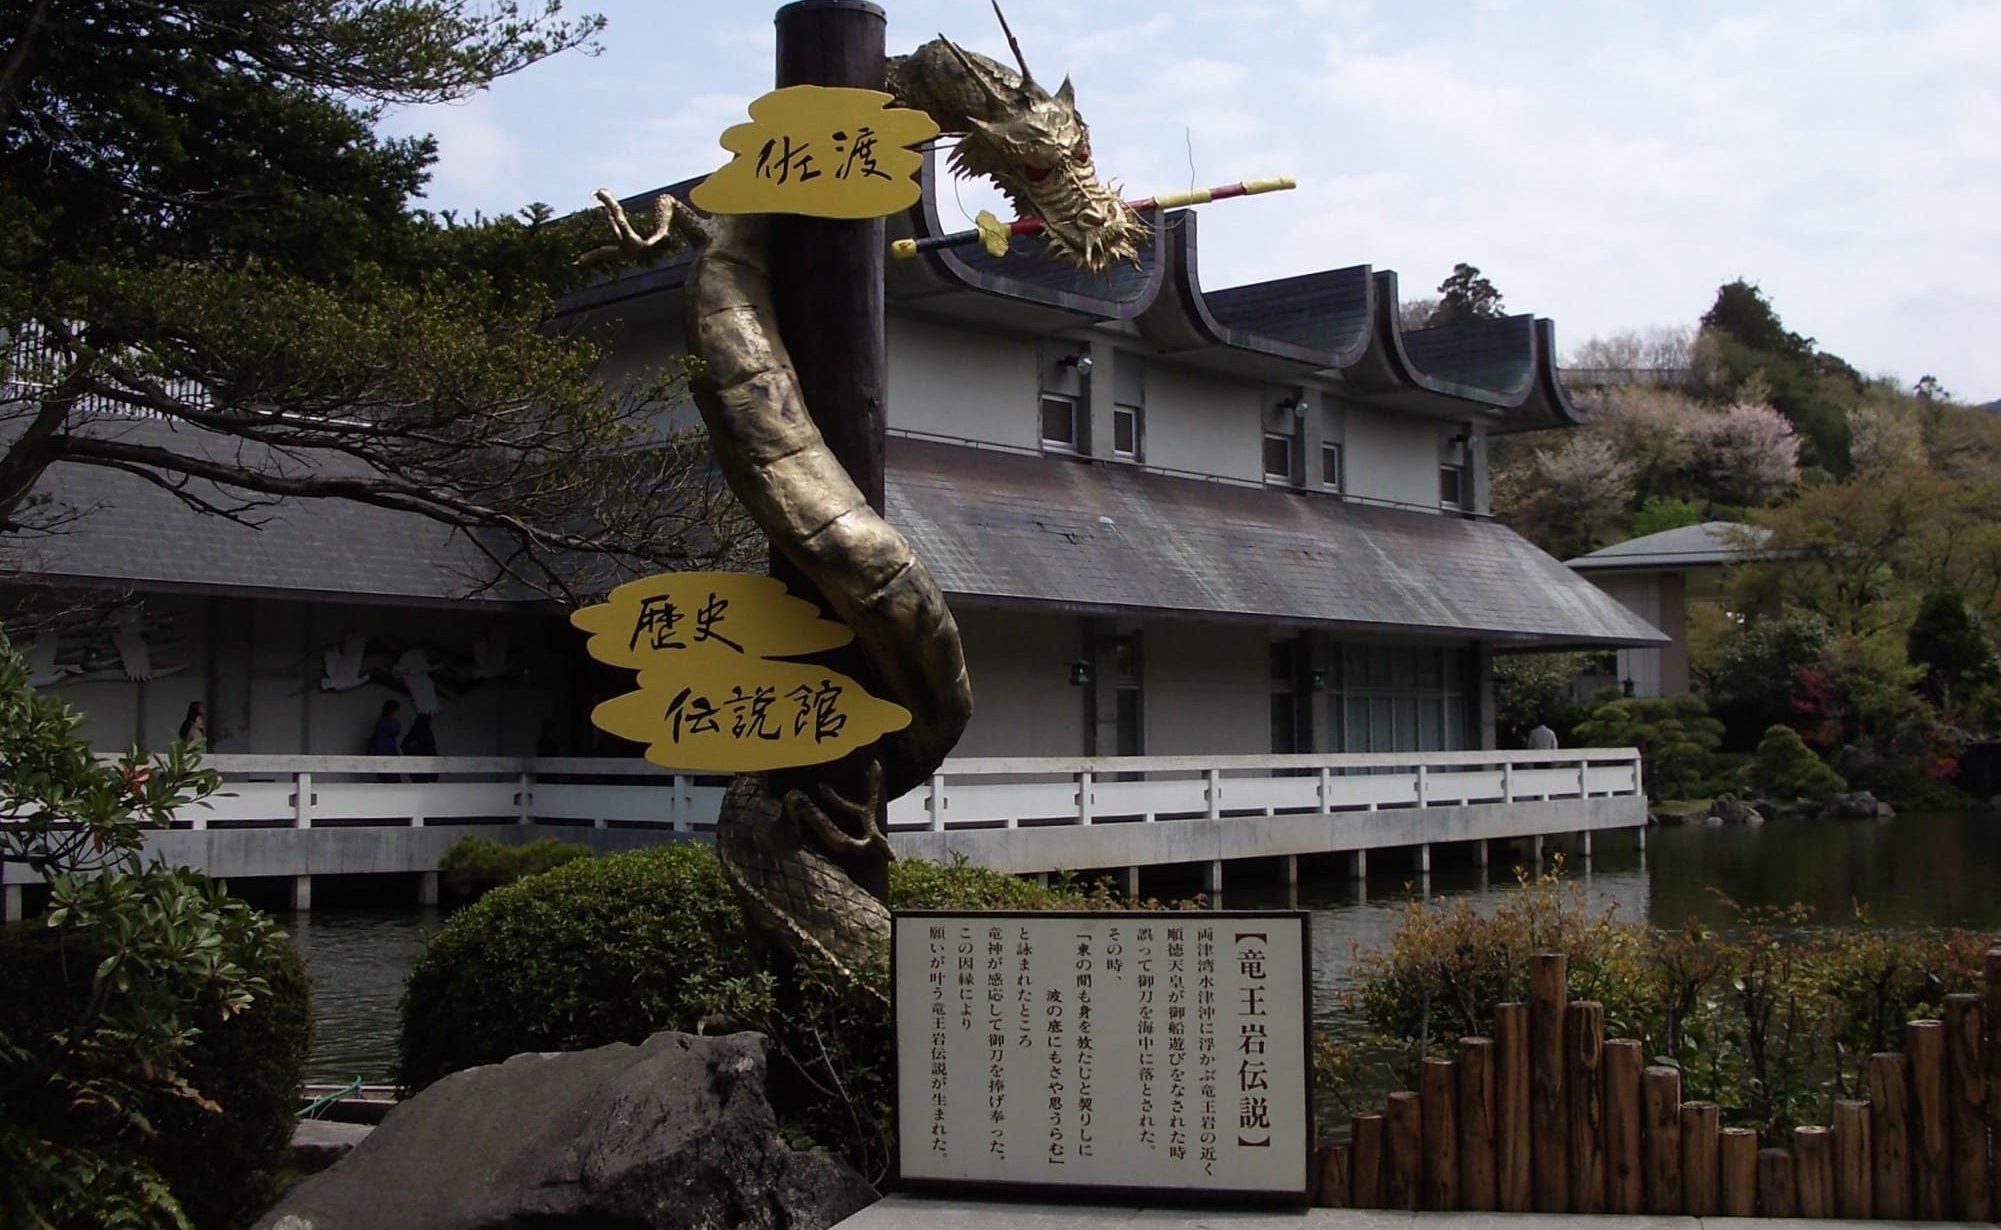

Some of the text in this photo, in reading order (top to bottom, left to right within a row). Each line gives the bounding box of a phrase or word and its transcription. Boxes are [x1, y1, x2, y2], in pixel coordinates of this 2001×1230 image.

[756, 126, 892, 185] 佐渡
[629, 592, 744, 654] 歴史
[664, 679, 848, 744] 伝説館
[1106, 927, 1123, 982] その時、
[1016, 927, 1033, 1049] と詠まれたところ
[1234, 932, 1271, 1148] 【竜王岩伝説】
